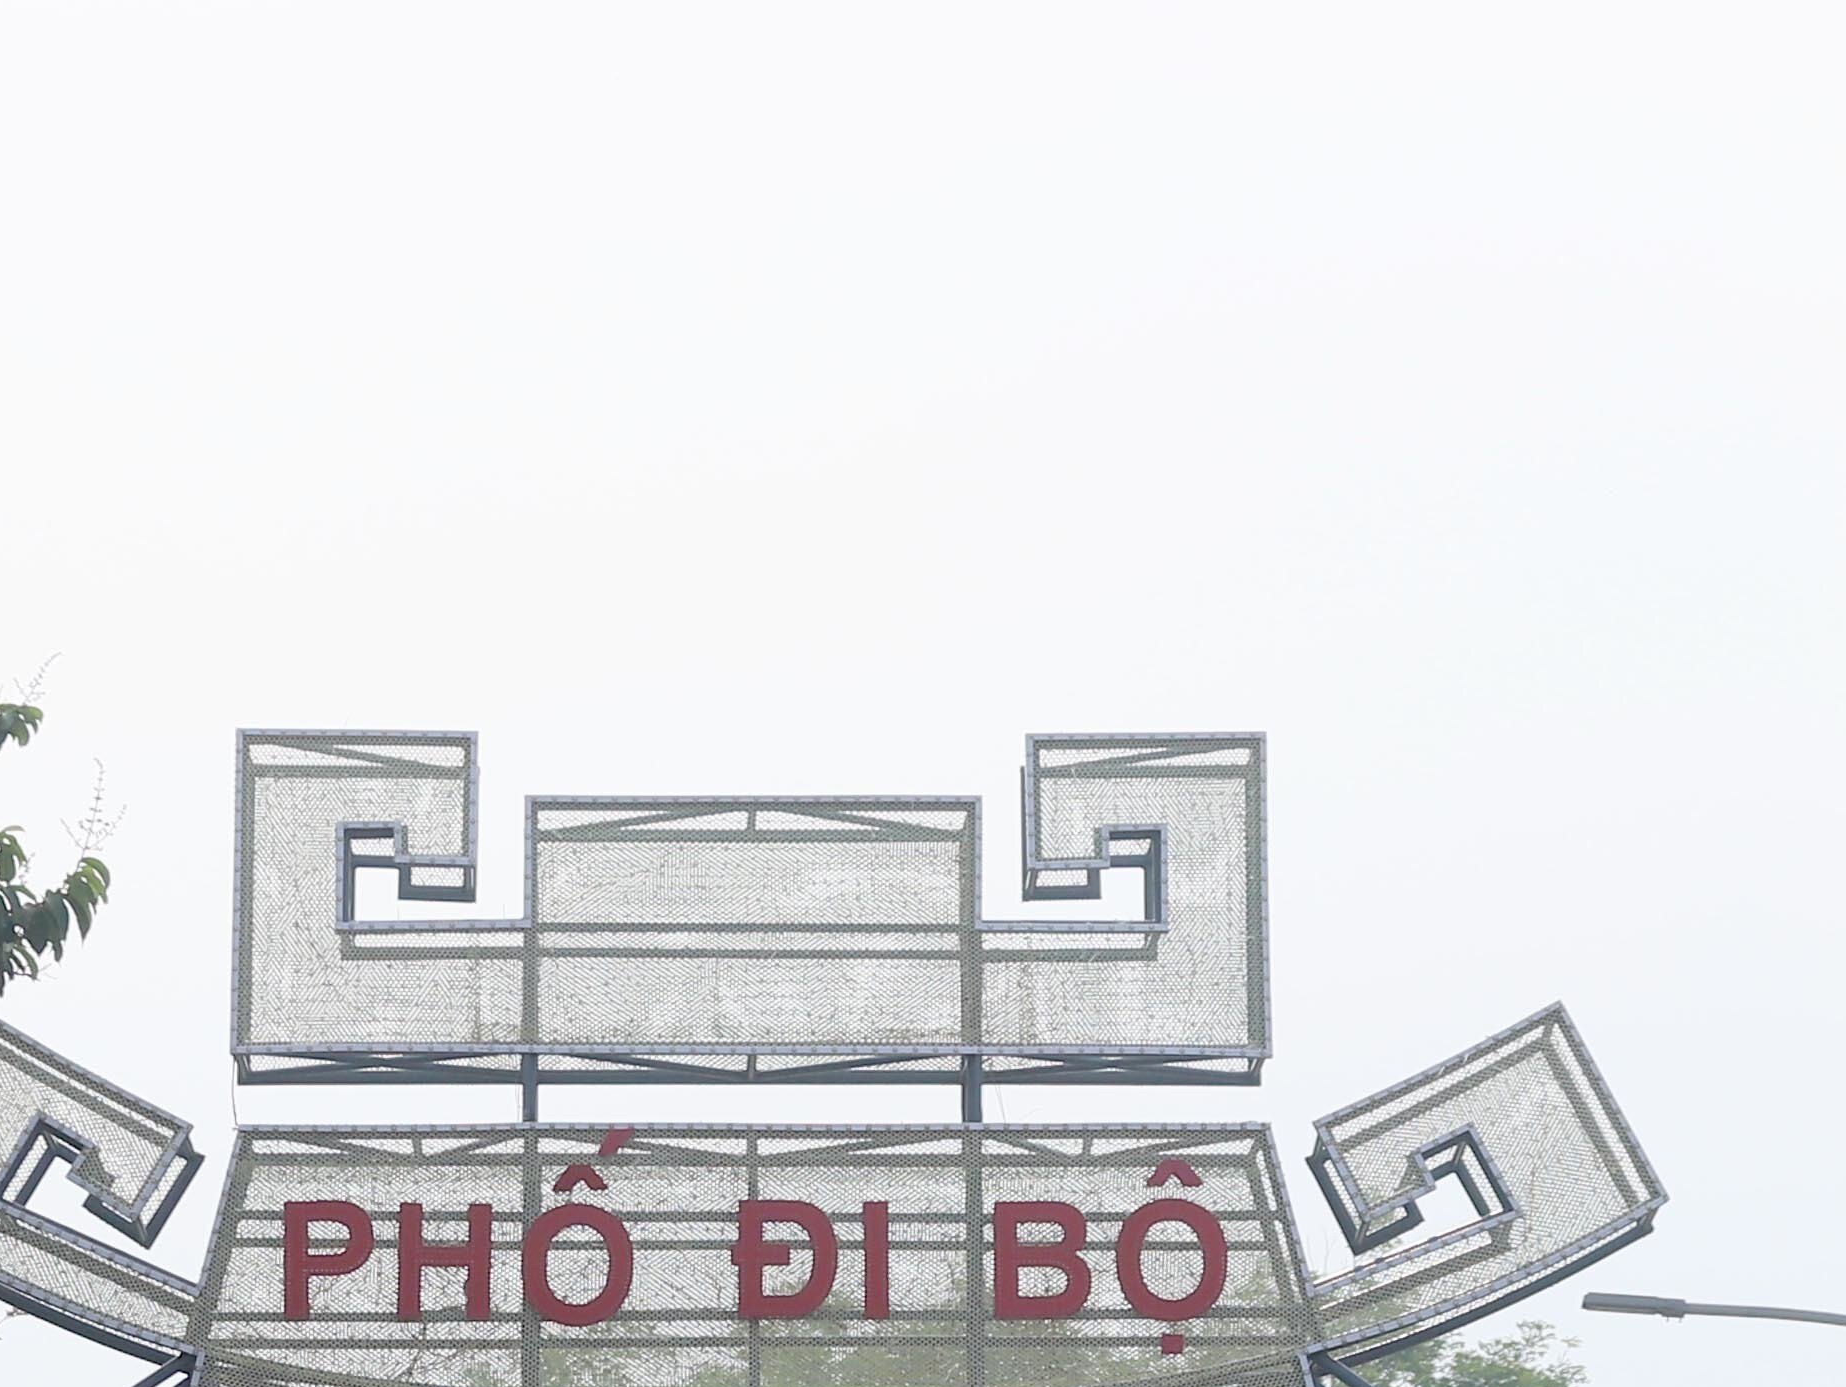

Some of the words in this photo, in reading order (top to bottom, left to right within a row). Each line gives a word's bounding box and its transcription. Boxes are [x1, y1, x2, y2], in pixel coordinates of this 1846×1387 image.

[282, 1127, 634, 1328] PHỐ
[732, 1200, 889, 1322] ĐI
[993, 1158, 1228, 1355] BỘ
